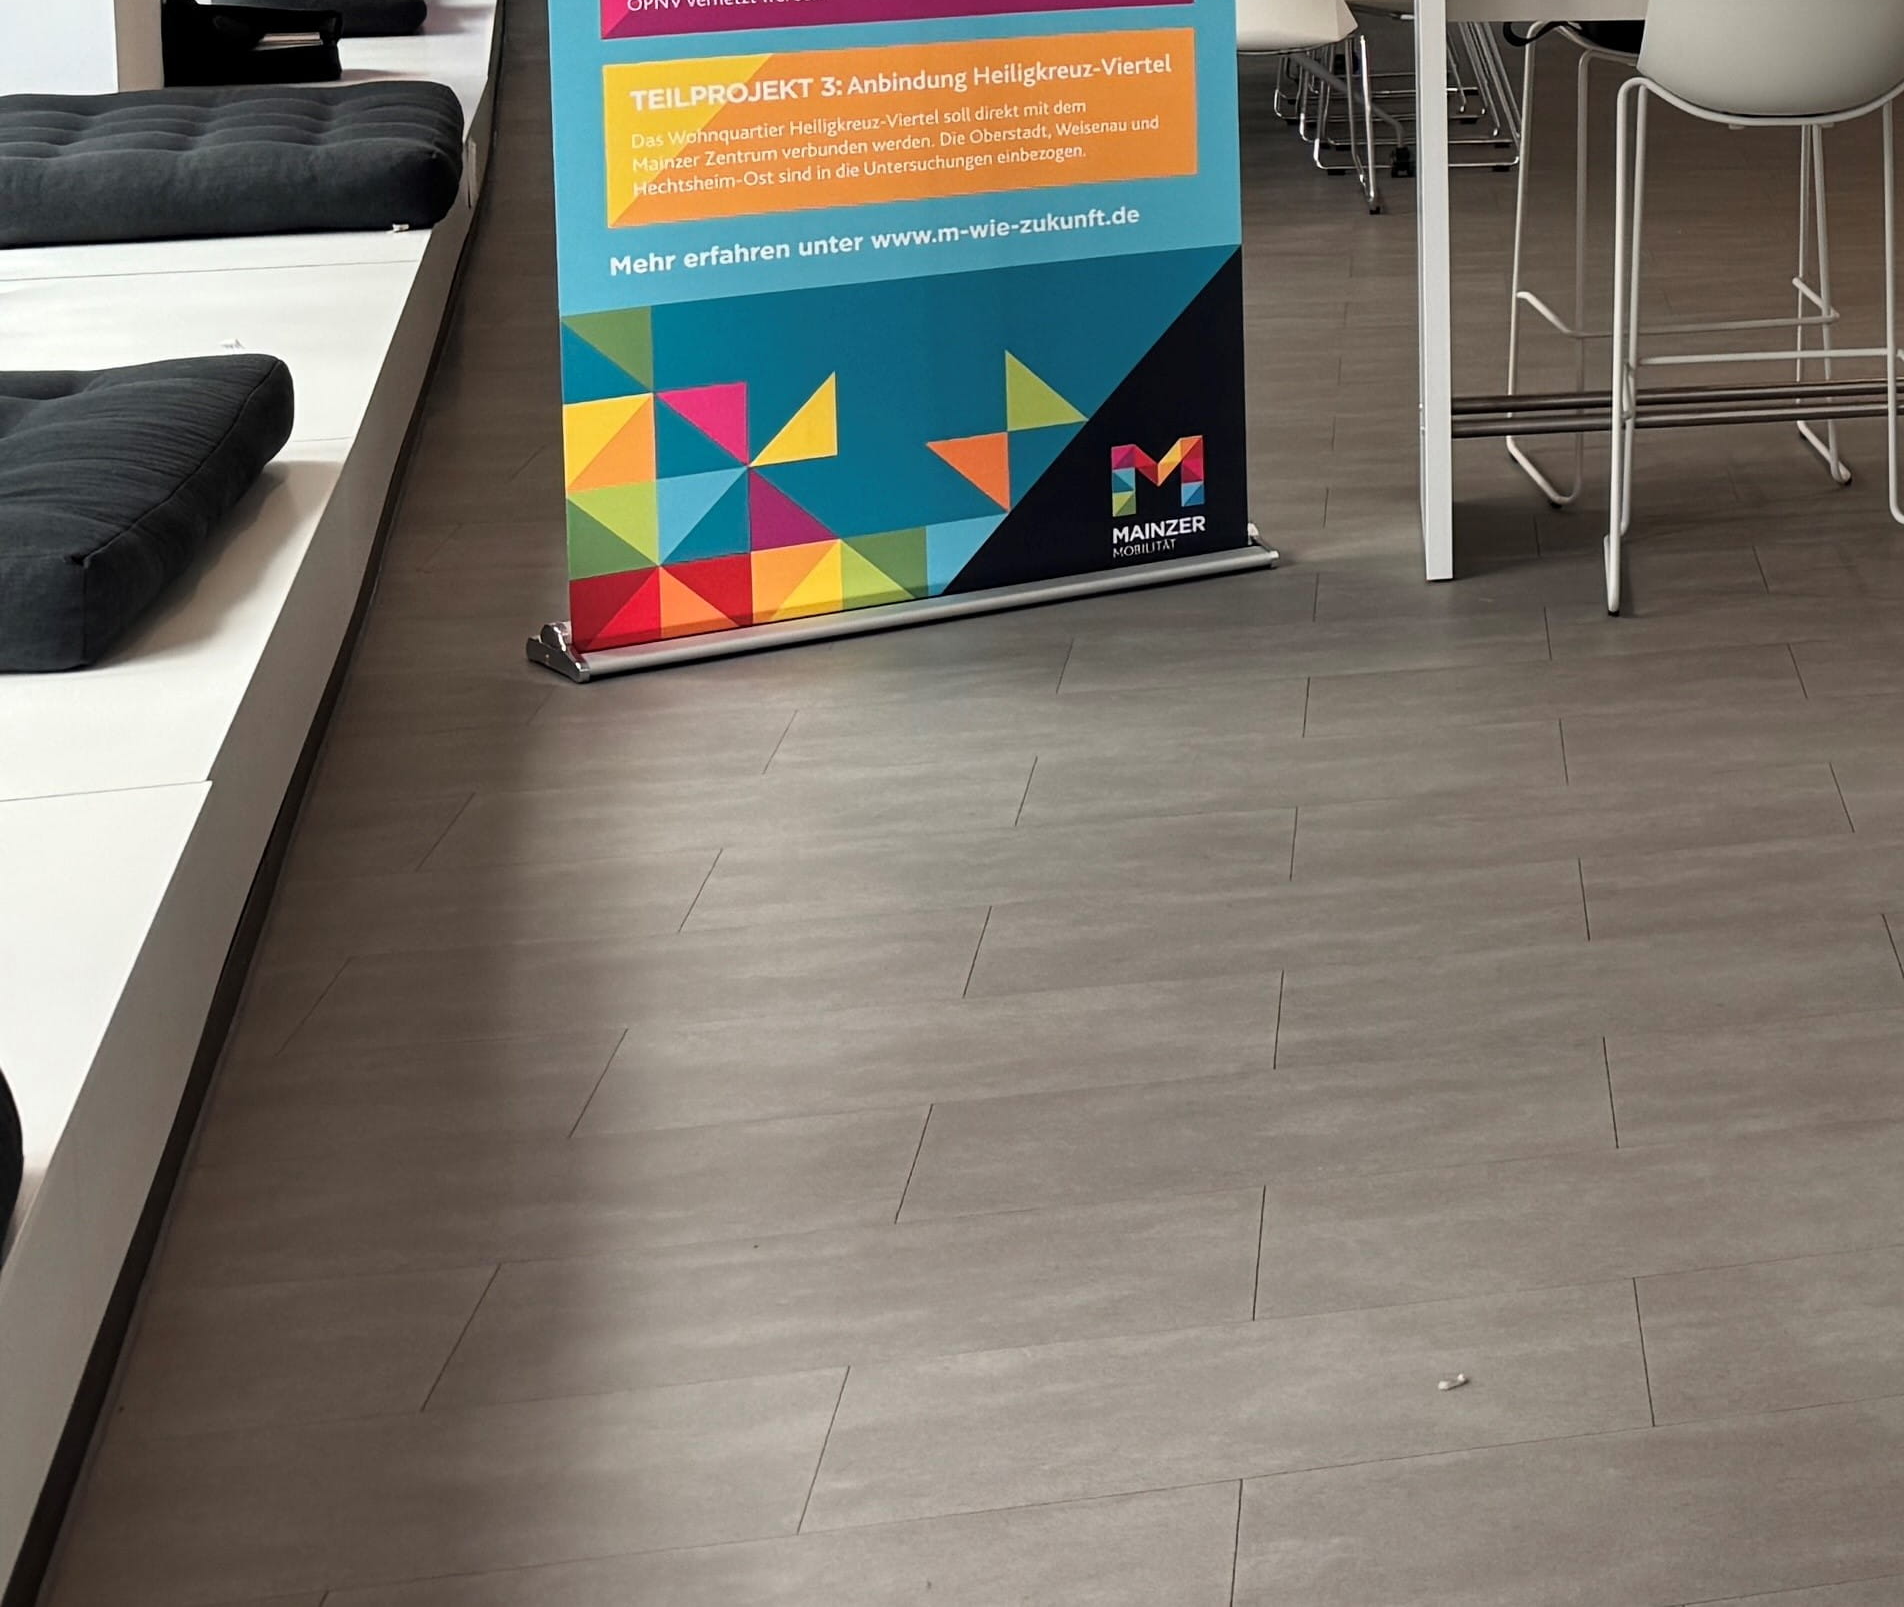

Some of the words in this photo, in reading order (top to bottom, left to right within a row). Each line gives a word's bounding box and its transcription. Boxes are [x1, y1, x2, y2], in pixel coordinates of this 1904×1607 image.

[630, 77, 814, 110] TEILPROJEKT
[819, 75, 843, 97] 3:
[846, 68, 967, 95] Anbindung
[972, 52, 1172, 88] Heiligkreuz-Viertel
[630, 132, 664, 149] Das
[667, 122, 785, 146] Wohnquartier
[788, 108, 939, 138] Heiligkreuz-Viertel
[942, 105, 971, 124] soll
[973, 102, 1019, 121] direkt
[1022, 100, 1049, 117] mit
[1052, 99, 1087, 115] dem
[631, 155, 700, 174] Mainzer
[704, 148, 778, 167] Zentrum
[780, 138, 868, 160] verbunden
[871, 133, 935, 152] werden.
[939, 130, 965, 147] Die
[968, 122, 1052, 144] Oberstadt,
[1054, 119, 1127, 136] Weisenau
[1130, 114, 1159, 131] und
[632, 170, 774, 198] Hechtsheim-Ost
[777, 164, 812, 184] sind
[816, 164, 831, 180] in
[834, 161, 860, 179] die
[862, 153, 993, 176] Untersuchungen
[996, 145, 1086, 164] einbezogen.
[609, 251, 676, 276] Mehr
[682, 242, 790, 268] erfahren
[797, 235, 864, 257] unter
[870, 205, 1140, 249] www.m-wie-zukunft.de
[1112, 515, 1206, 544] MAINZER
